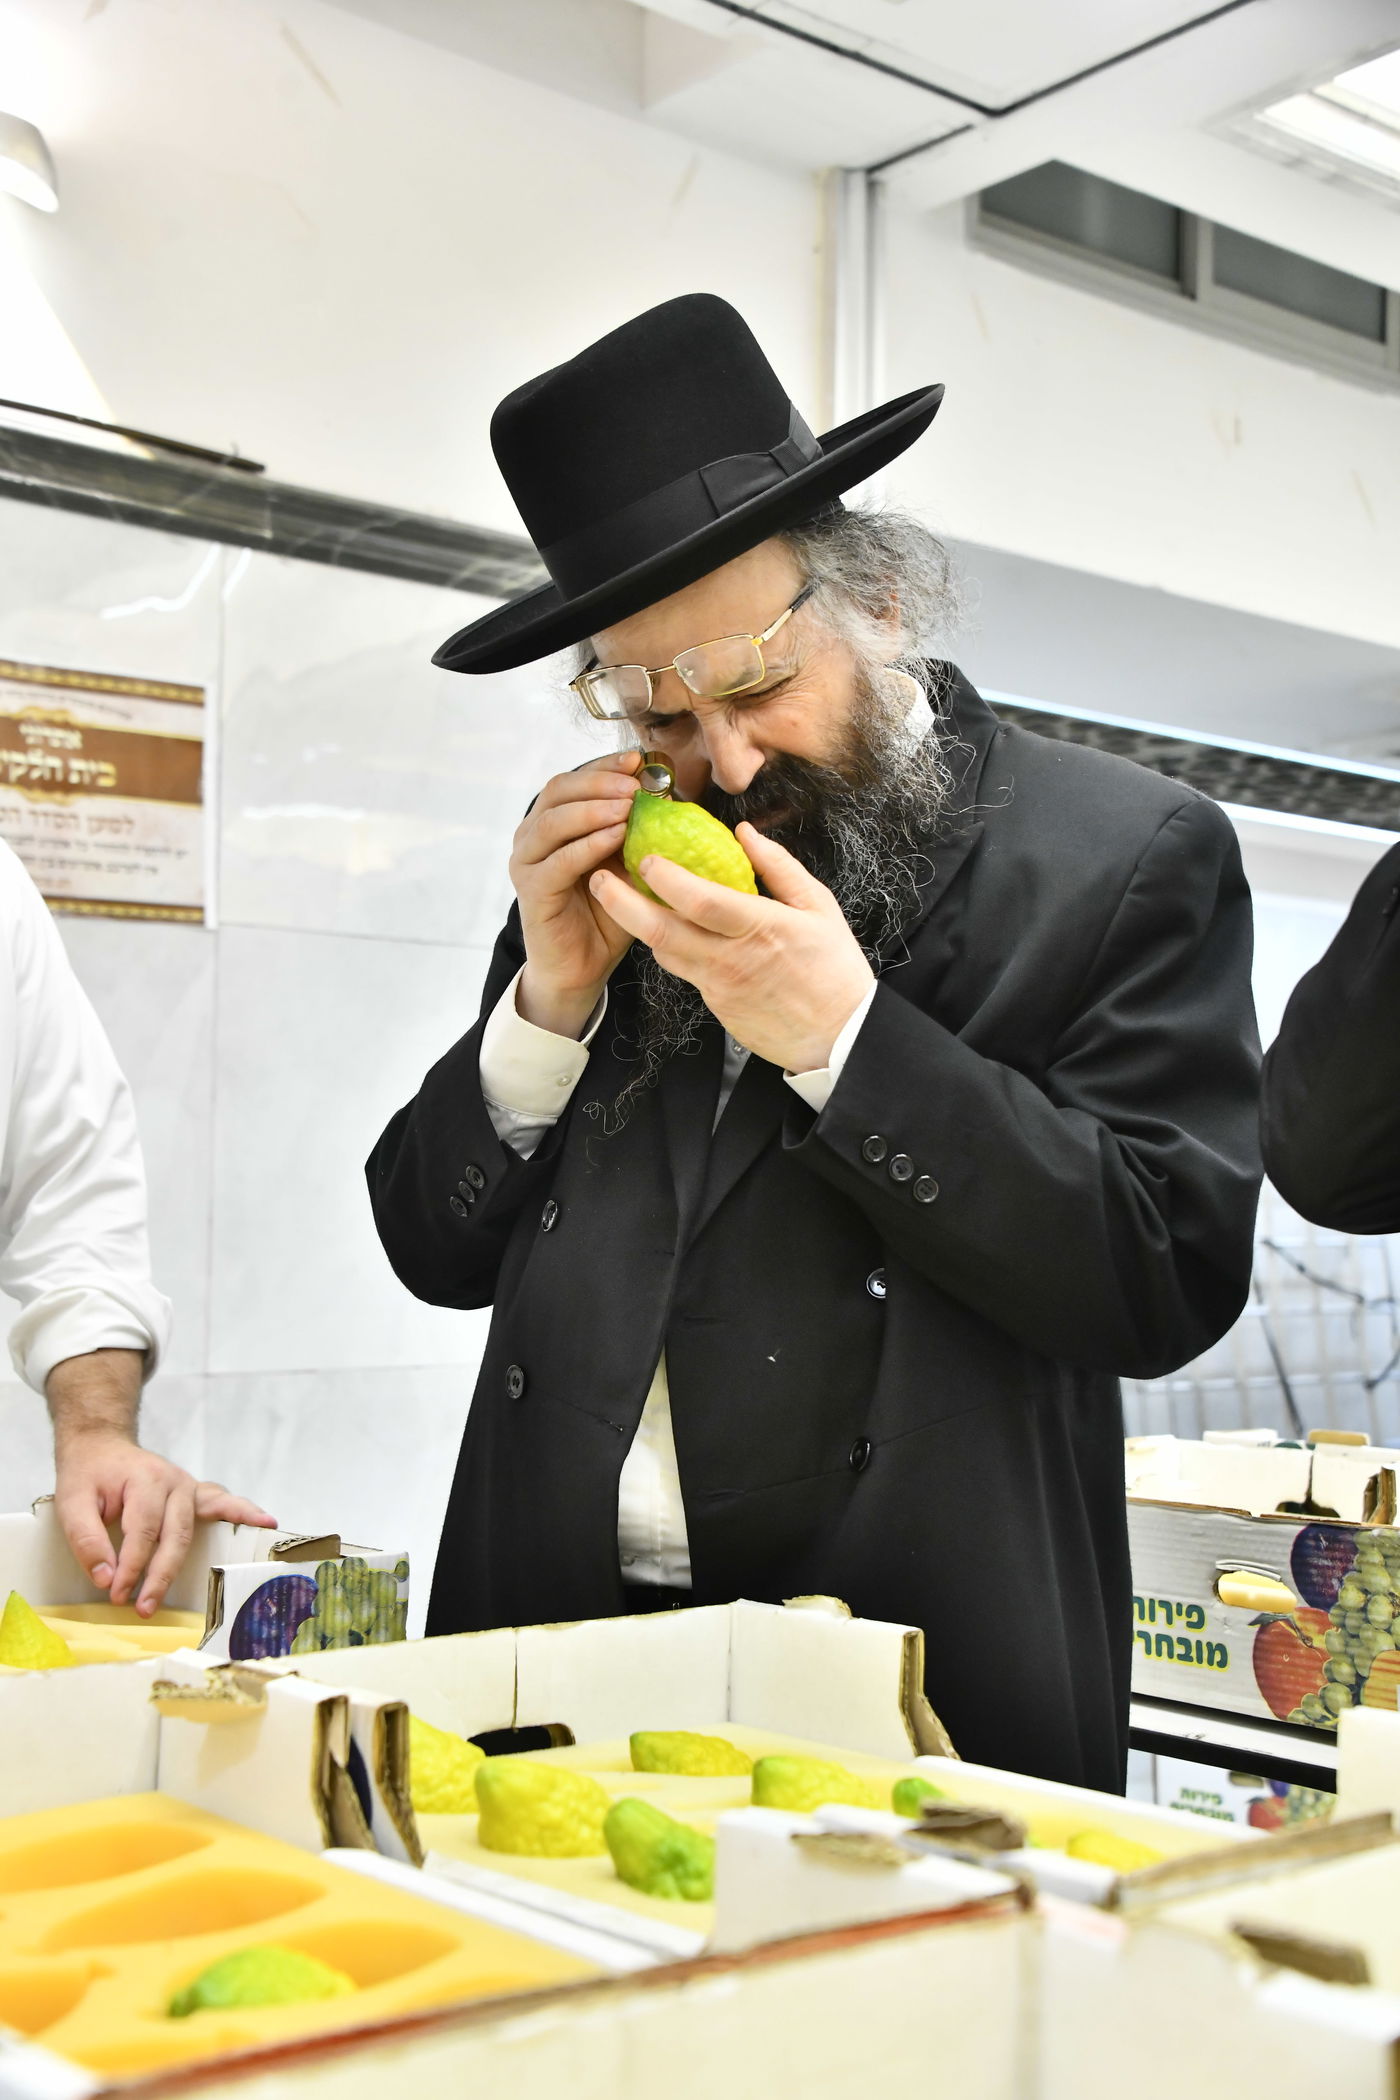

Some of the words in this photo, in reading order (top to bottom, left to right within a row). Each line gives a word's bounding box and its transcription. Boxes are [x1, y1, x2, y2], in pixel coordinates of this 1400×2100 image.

[0, 749, 63, 783] חלקי
[68, 758, 116, 787] בית
[1133, 1630, 1229, 1670] מובחר
